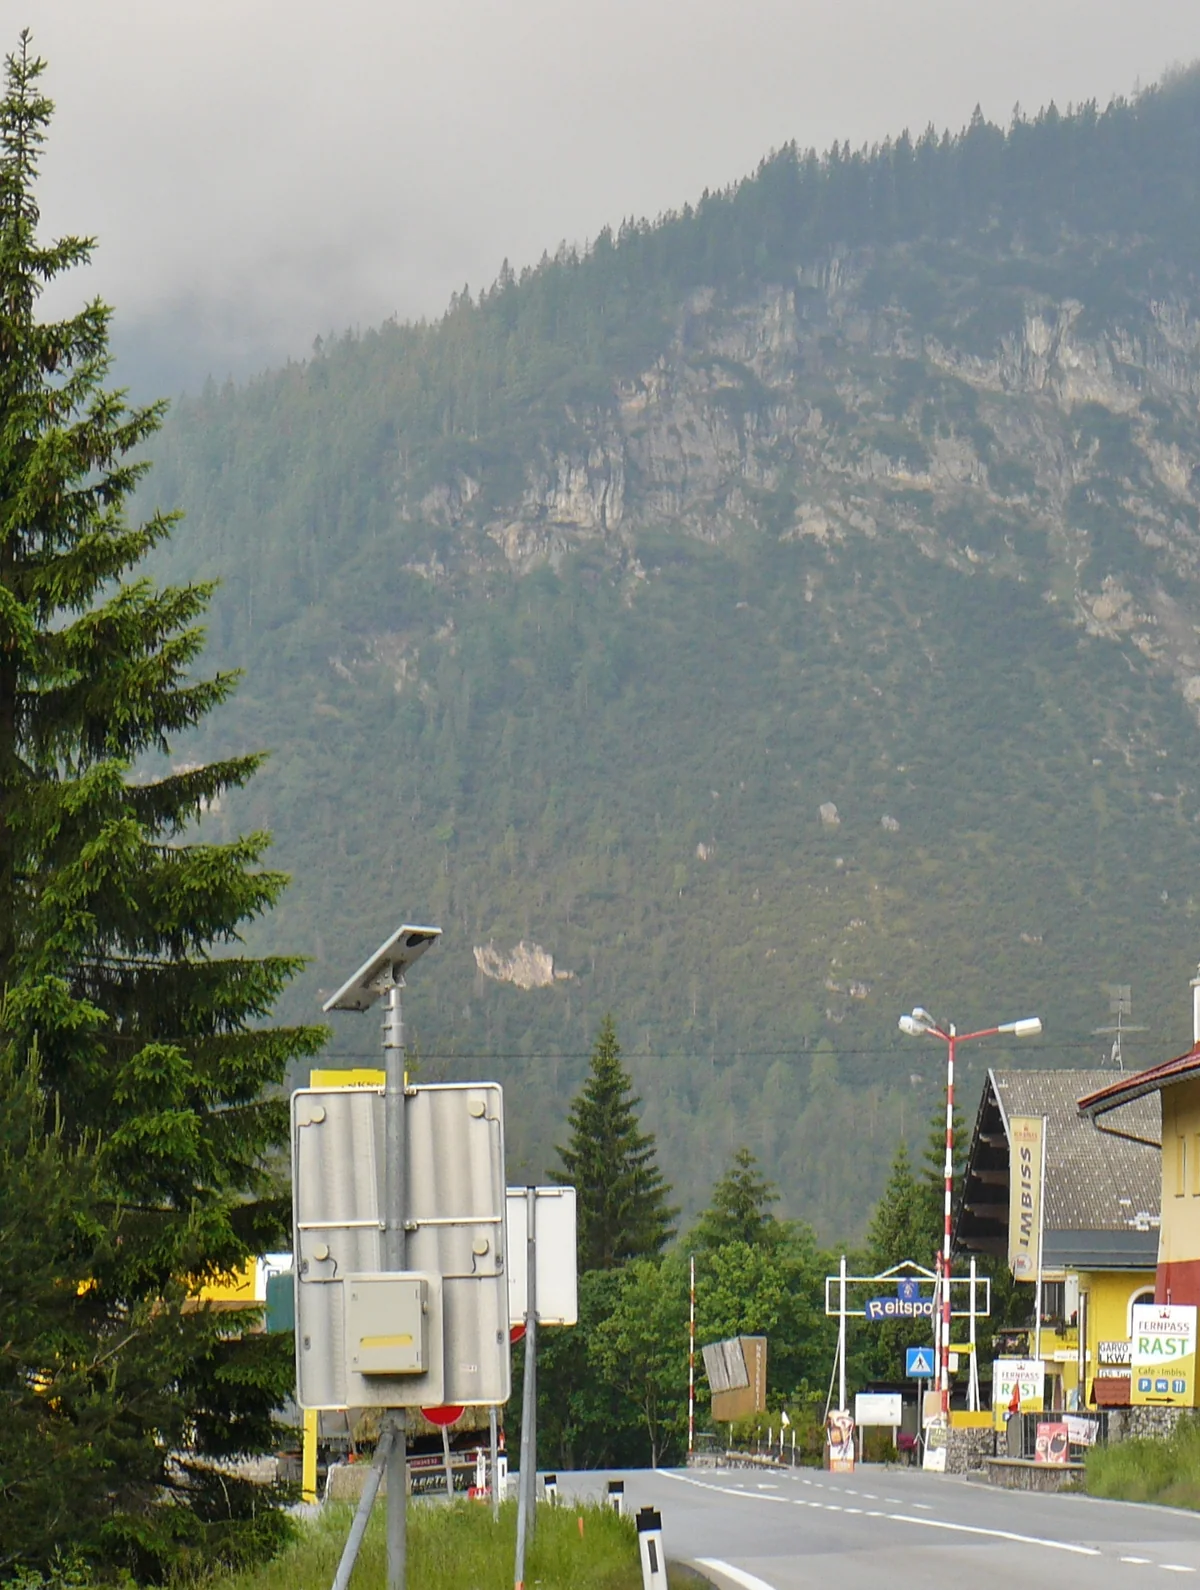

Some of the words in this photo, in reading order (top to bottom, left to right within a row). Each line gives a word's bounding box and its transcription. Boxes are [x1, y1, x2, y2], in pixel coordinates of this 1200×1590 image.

[1019, 1147, 1033, 1247] IMBISS
[869, 1299, 940, 1318] Reitspo
[1138, 1321, 1190, 1332] FERNPASS
[1138, 1337, 1189, 1355] RAST
[1001, 1371, 1040, 1379] FERNPASS
[1161, 1367, 1186, 1377] Imbiss
[1001, 1383, 1037, 1396] RST
[1142, 1381, 1149, 1389] P
